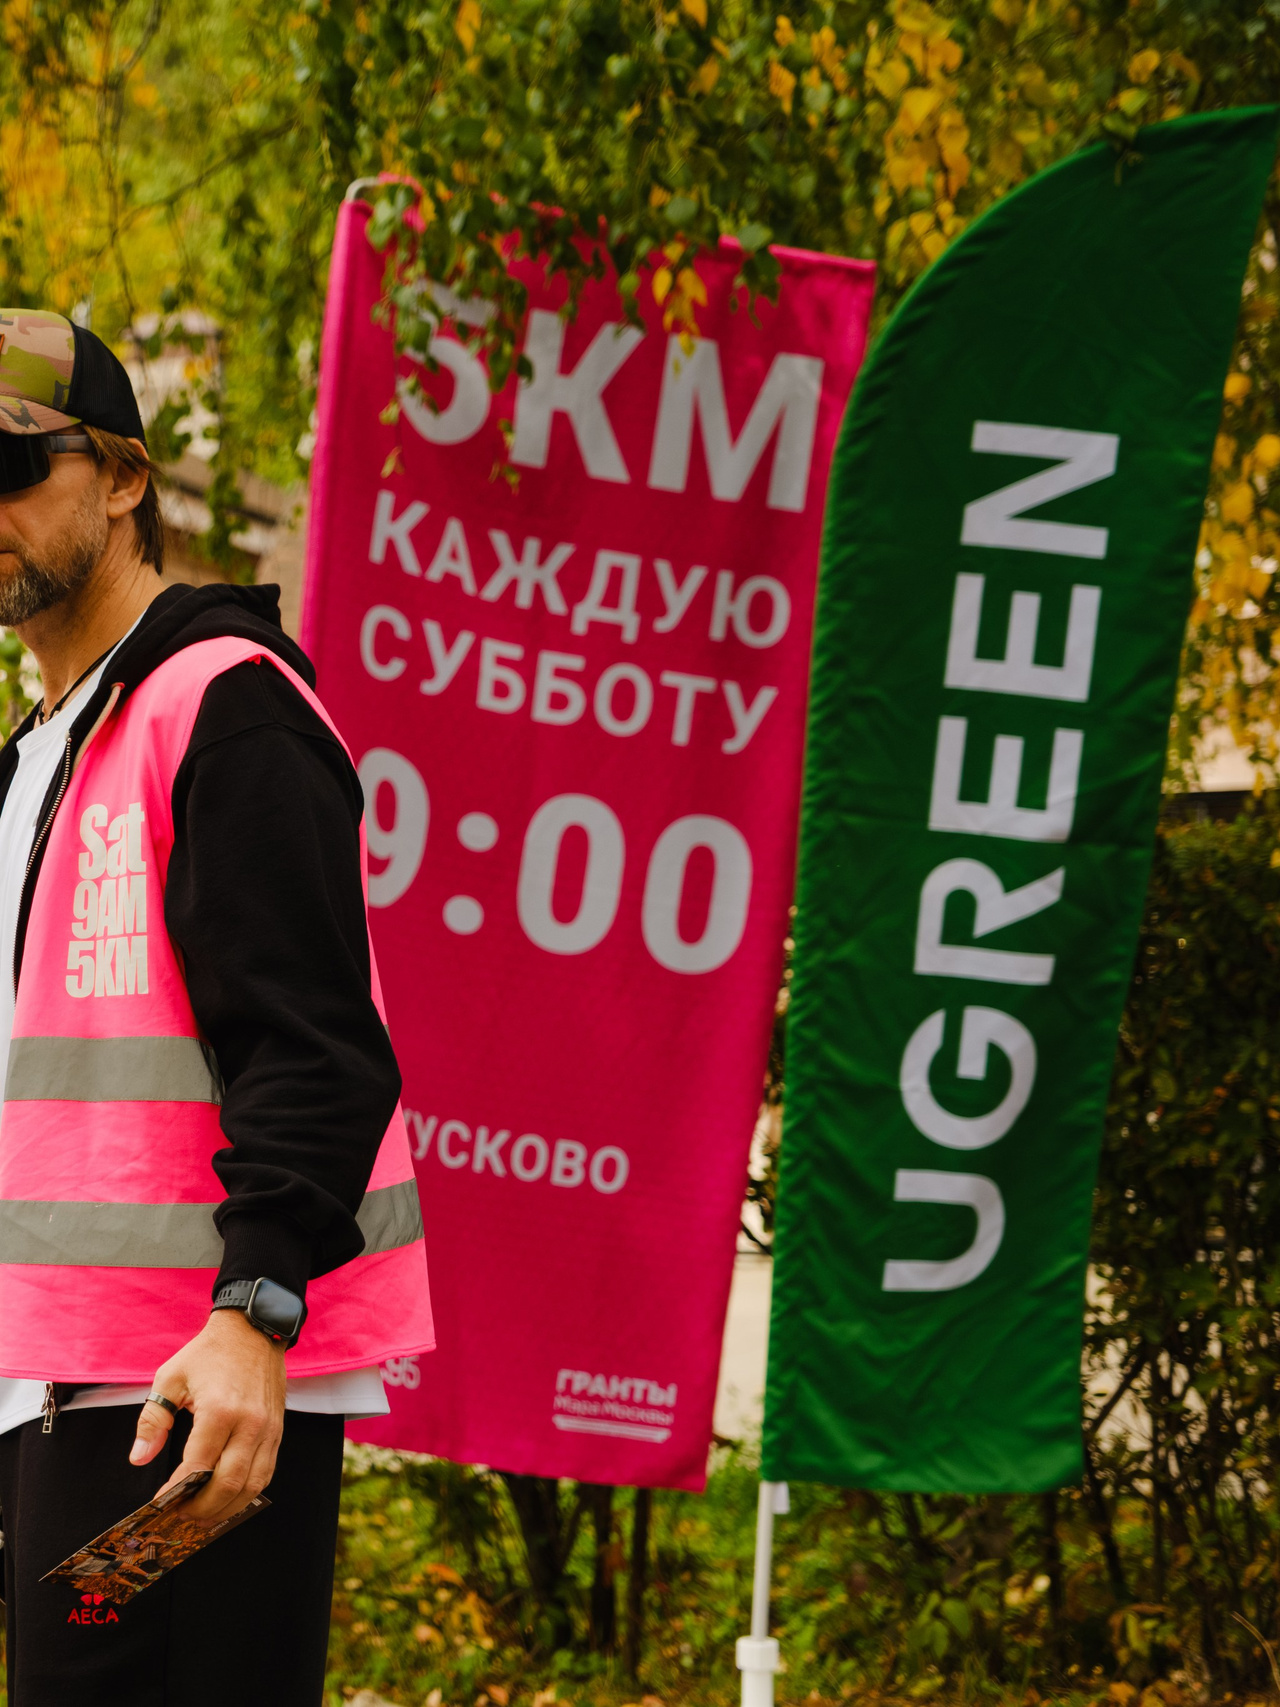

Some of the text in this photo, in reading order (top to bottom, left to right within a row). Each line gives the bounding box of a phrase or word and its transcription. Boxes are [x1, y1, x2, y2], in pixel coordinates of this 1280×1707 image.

[368, 490, 792, 649] КАЖДУЮ
[359, 604, 779, 754] СУББОТУ
[78, 802, 146, 880] Sat
[357, 746, 752, 975] 9:00
[882, 419, 1120, 1294] UGREEN
[71, 874, 147, 939] 9AM
[65, 935, 149, 998] 5KM
[403, 1108, 630, 1194] УСКОВО
[380, 1355, 421, 1389] 95
[556, 1368, 677, 1407] ГРАНТЫ
[67, 1608, 119, 1624] AECA
